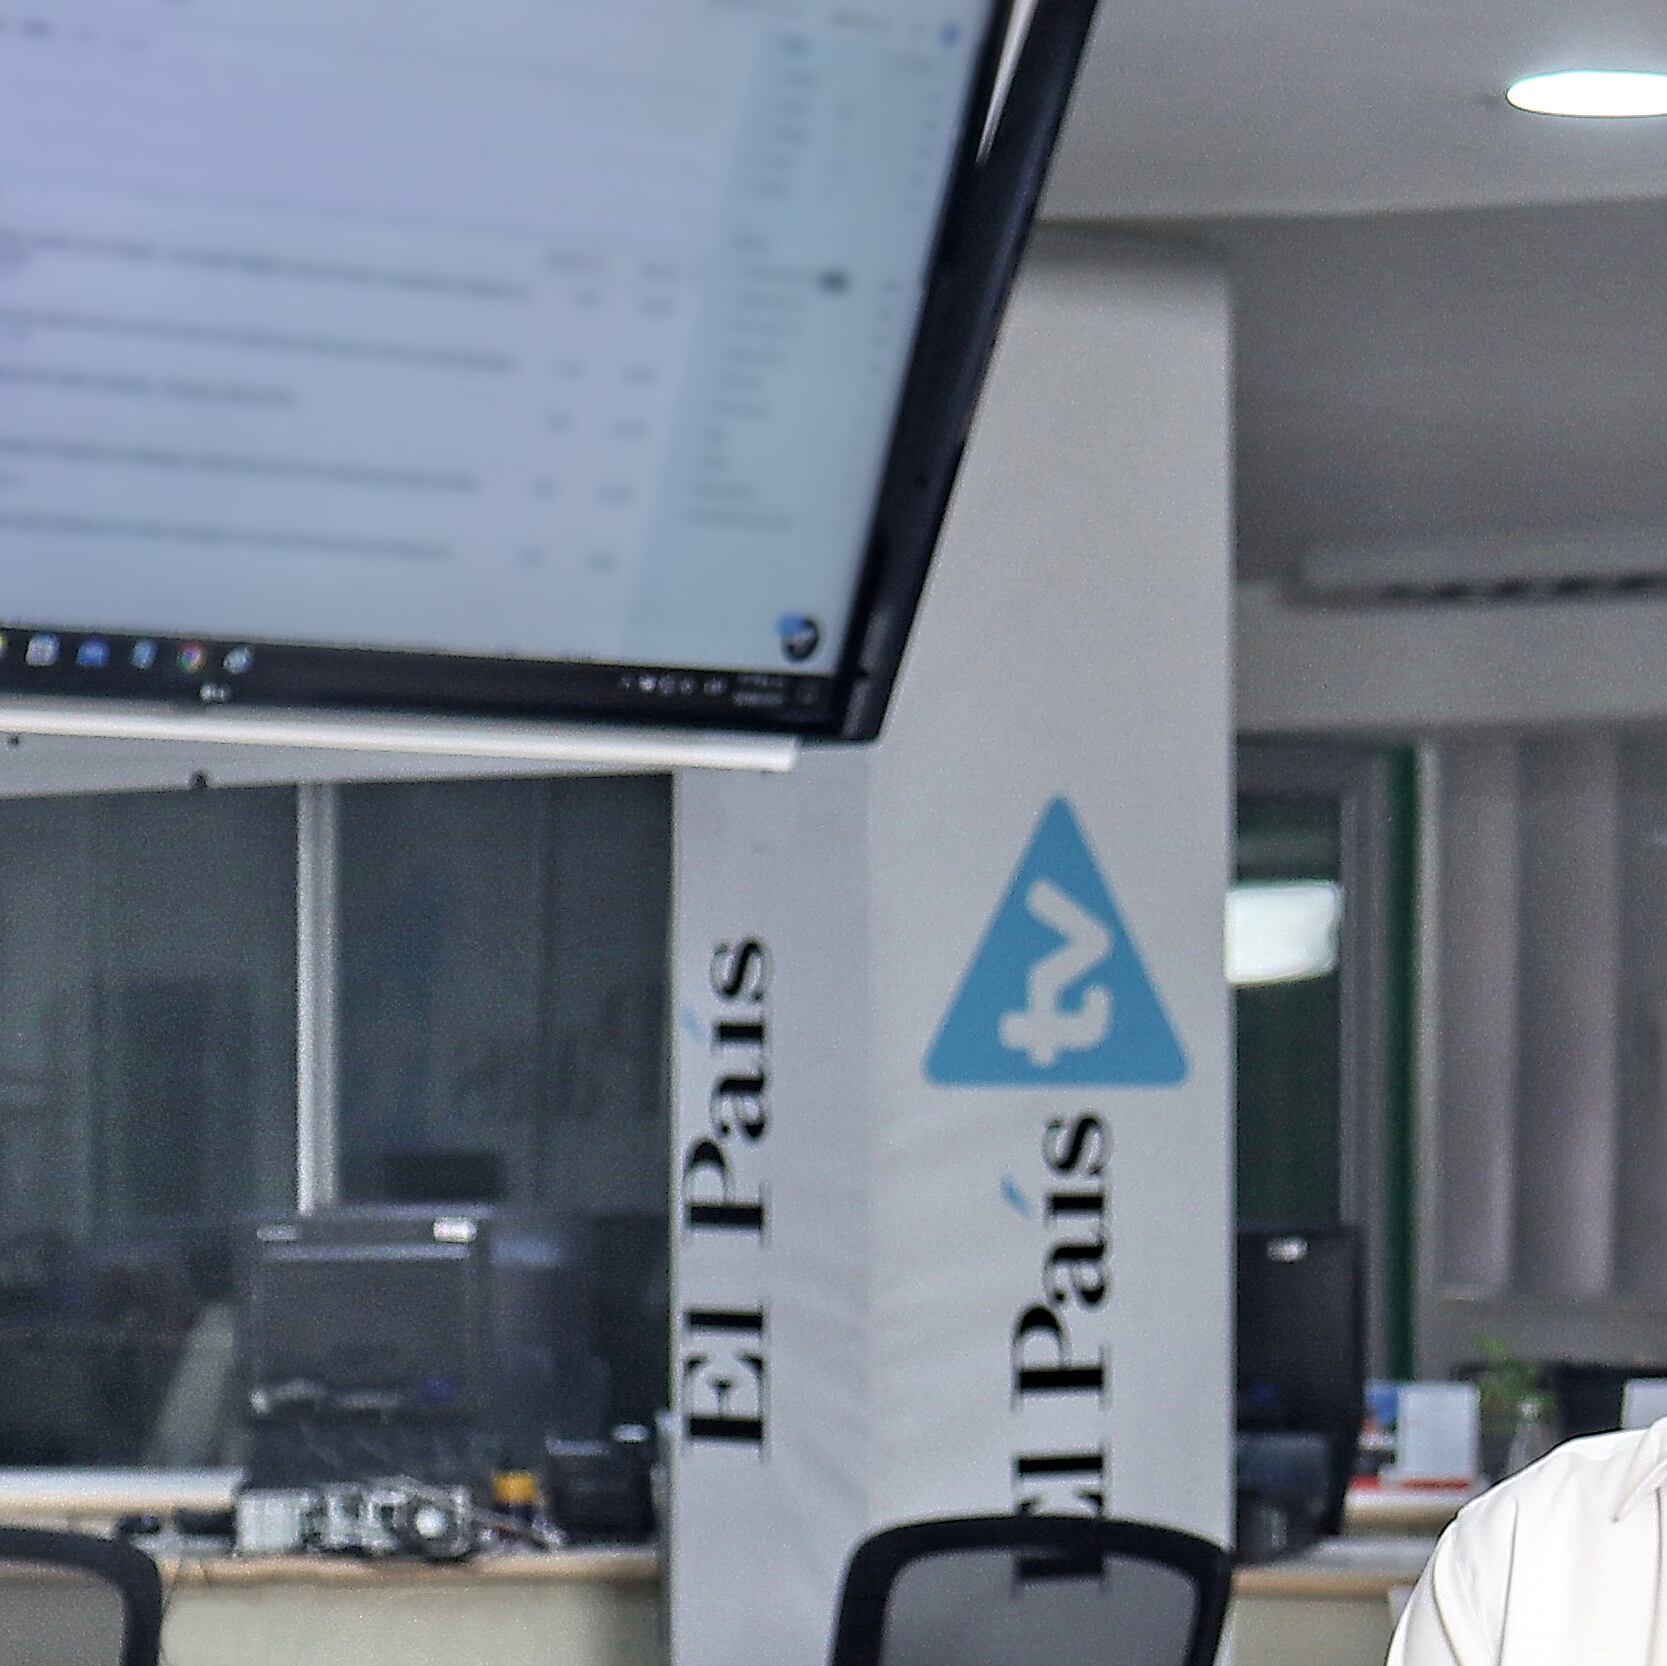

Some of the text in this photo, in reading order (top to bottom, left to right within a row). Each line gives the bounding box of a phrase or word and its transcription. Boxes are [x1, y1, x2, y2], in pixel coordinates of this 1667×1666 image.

[999, 879, 1112, 1068] tv
[682, 936, 771, 1463] El País
[1002, 1110, 1112, 1412] País
